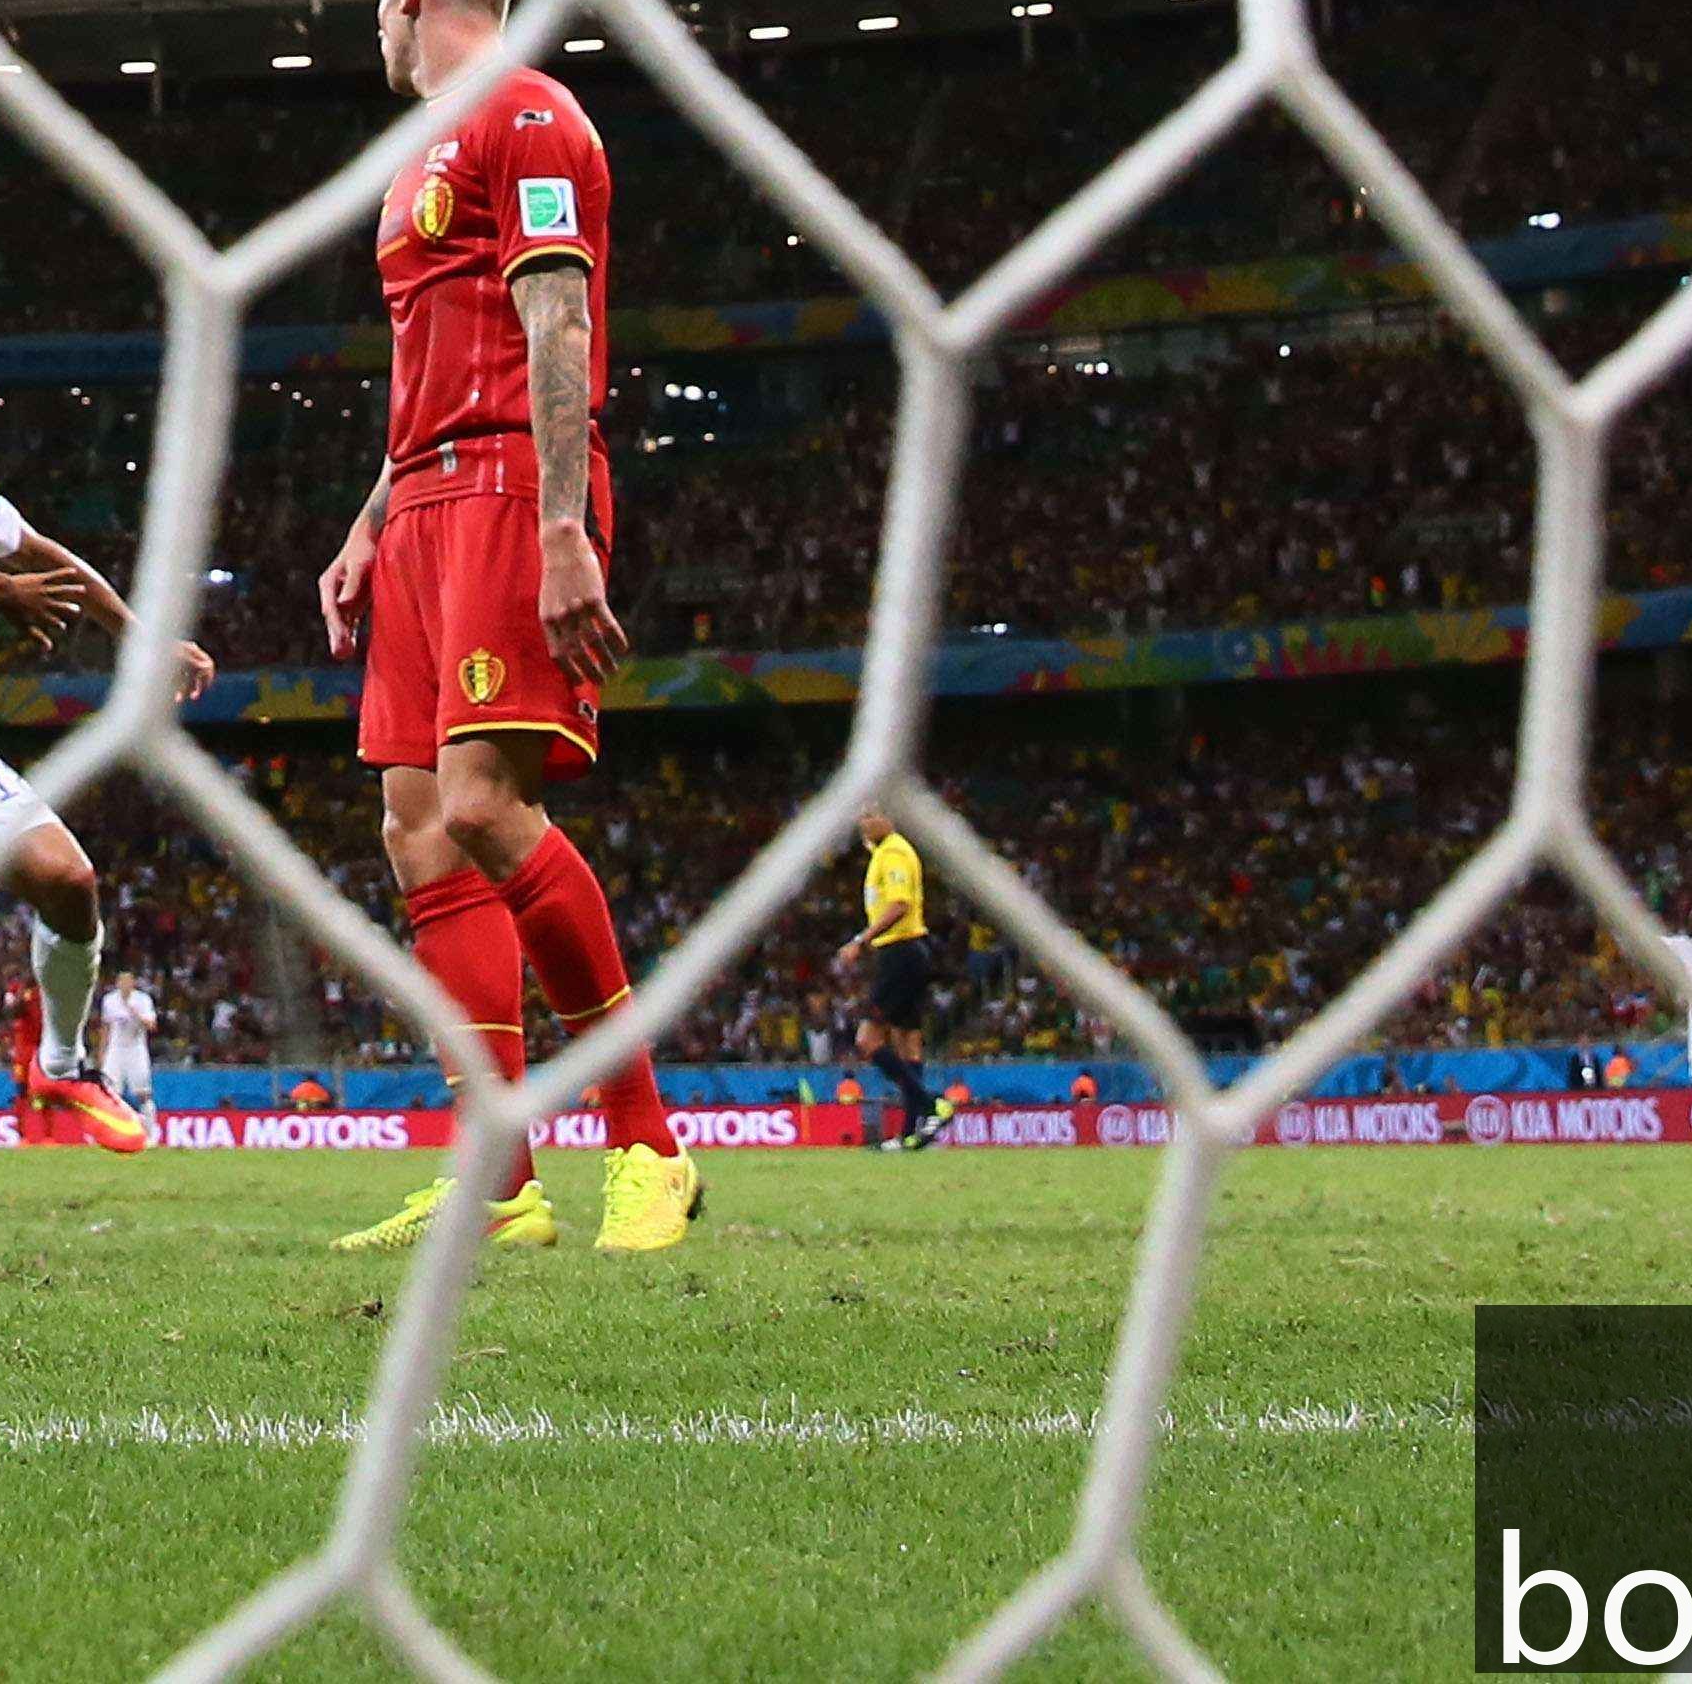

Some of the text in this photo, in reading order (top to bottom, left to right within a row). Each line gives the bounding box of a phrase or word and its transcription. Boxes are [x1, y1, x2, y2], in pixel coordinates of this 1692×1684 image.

[166, 1114, 409, 1150] KIA MOTORS
[665, 1109, 799, 1147] OTORS
[1511, 1099, 1556, 1141] KIA
[1557, 1096, 1663, 1142] MOTORS
